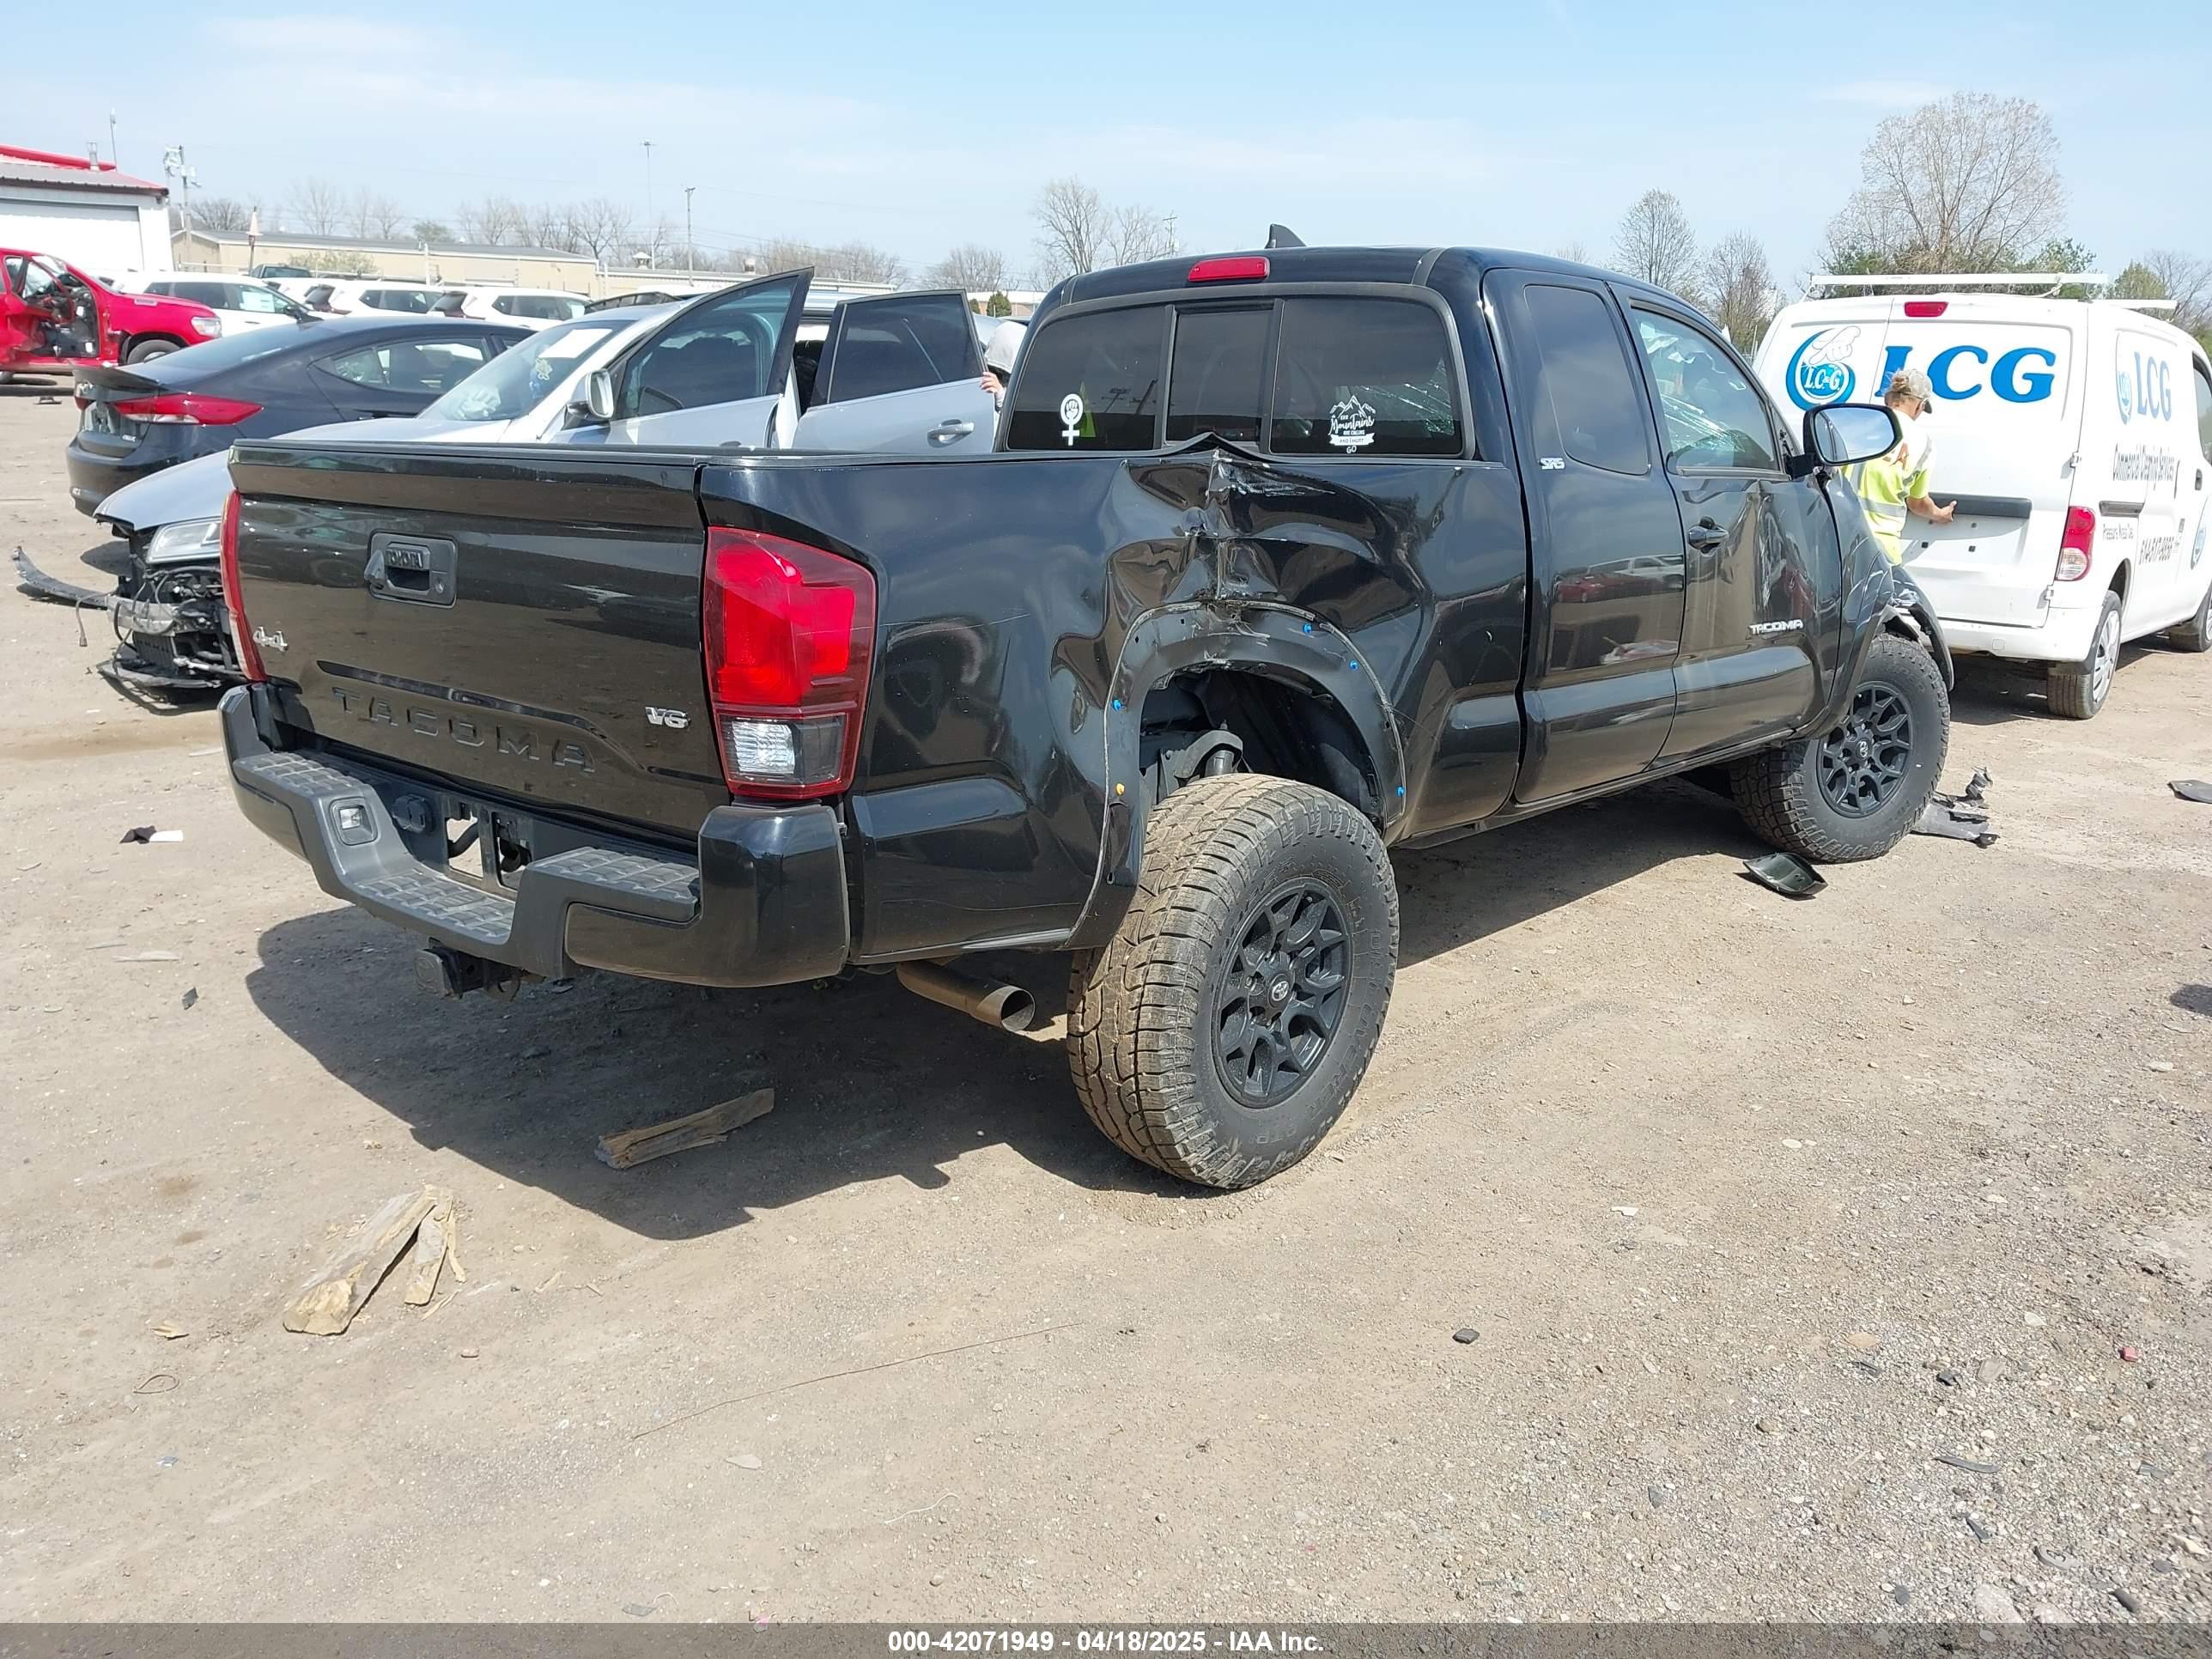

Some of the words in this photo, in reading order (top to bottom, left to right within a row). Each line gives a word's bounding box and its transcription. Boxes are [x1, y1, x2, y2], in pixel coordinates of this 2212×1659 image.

[1874, 344, 2057, 404] LCG
[2134, 352, 2173, 422] LCG
[1346, 445, 1357, 454] GO
[385, 549, 424, 568] TOYOTA
[252, 626, 289, 652] 4x4
[1749, 619, 1804, 635] TACOMA
[645, 706, 689, 729] V6
[331, 686, 597, 774] TACOMA
